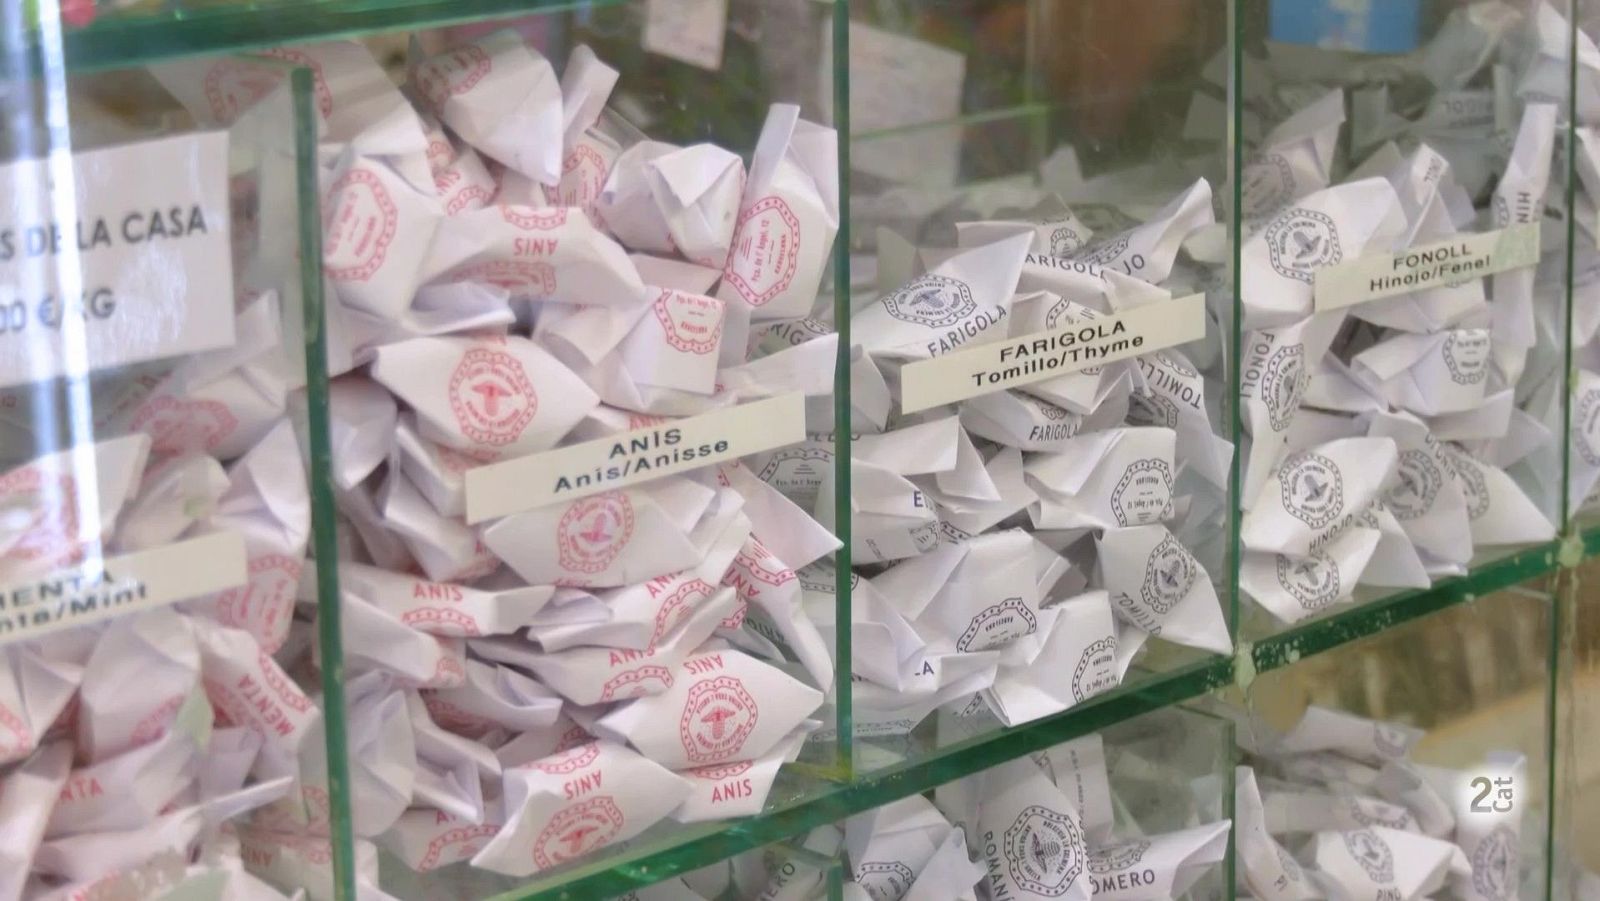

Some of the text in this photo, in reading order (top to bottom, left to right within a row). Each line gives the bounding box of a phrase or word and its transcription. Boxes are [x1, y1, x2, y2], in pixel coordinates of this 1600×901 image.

[77, 218, 112, 251] LA
[122, 206, 208, 245] CASA
[514, 238, 559, 256] ANIS
[1392, 243, 1473, 271] FONOLL
[927, 304, 1008, 359] FARIGOLA
[999, 320, 1127, 363] FARIGOLA
[971, 334, 1145, 388] Tomillo/Thyme
[608, 427, 683, 460] ANIS
[553, 439, 730, 495] Anis/Anisse
[1308, 513, 1354, 552] HINOJO
[413, 582, 464, 602] ANIS
[683, 653, 725, 676] ANIS
[237, 673, 296, 737] MENTA
[563, 769, 602, 801] ANIS
[711, 778, 753, 805] ANIS
